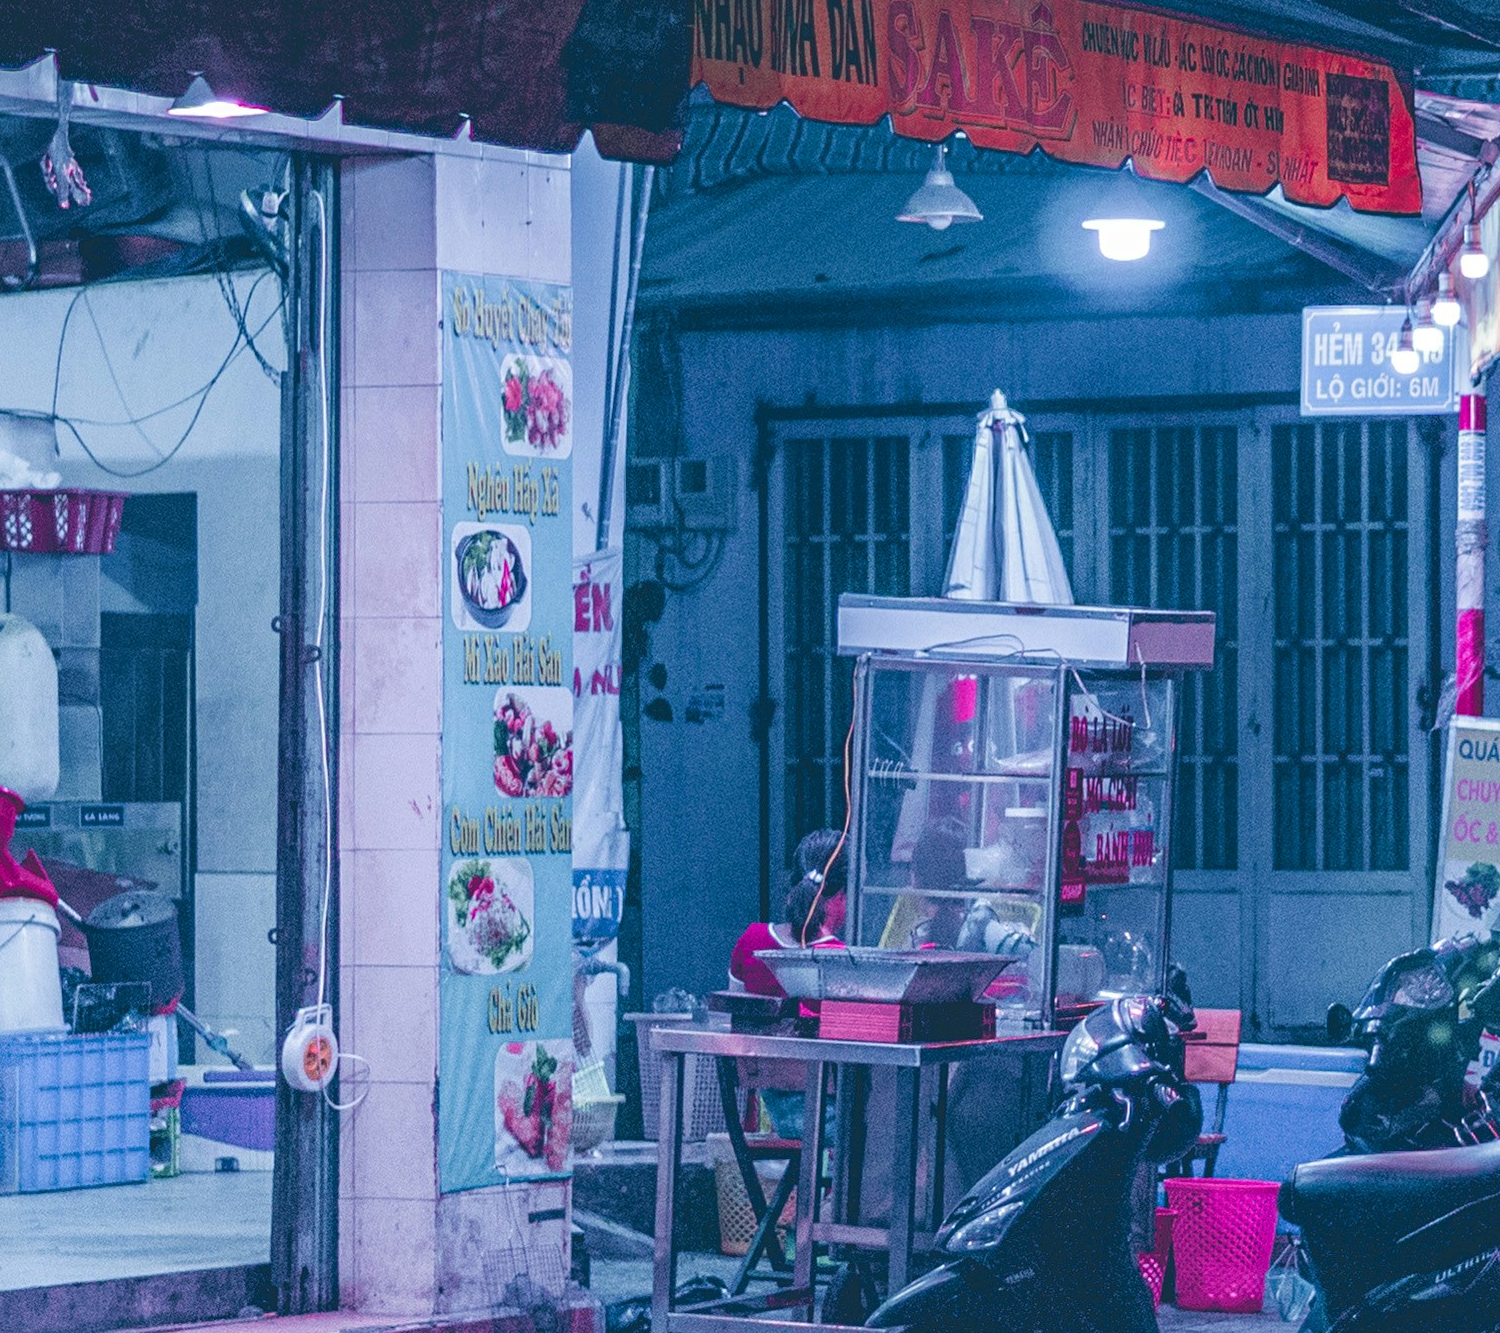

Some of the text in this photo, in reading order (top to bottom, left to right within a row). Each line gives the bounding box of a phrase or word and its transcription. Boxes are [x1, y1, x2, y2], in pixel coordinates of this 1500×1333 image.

[1314, 322, 1363, 366] HẺM
[1316, 373, 1439, 403] LỘ GIỚI: 6M
[466, 460, 510, 522] Nghêu
[512, 630, 534, 685] Hải
[538, 630, 562, 685] Sản
[484, 804, 522, 856] Chiên
[524, 800, 547, 855] Hải
[1453, 811, 1482, 843] ỐC
[1486, 821, 1499, 845] &
